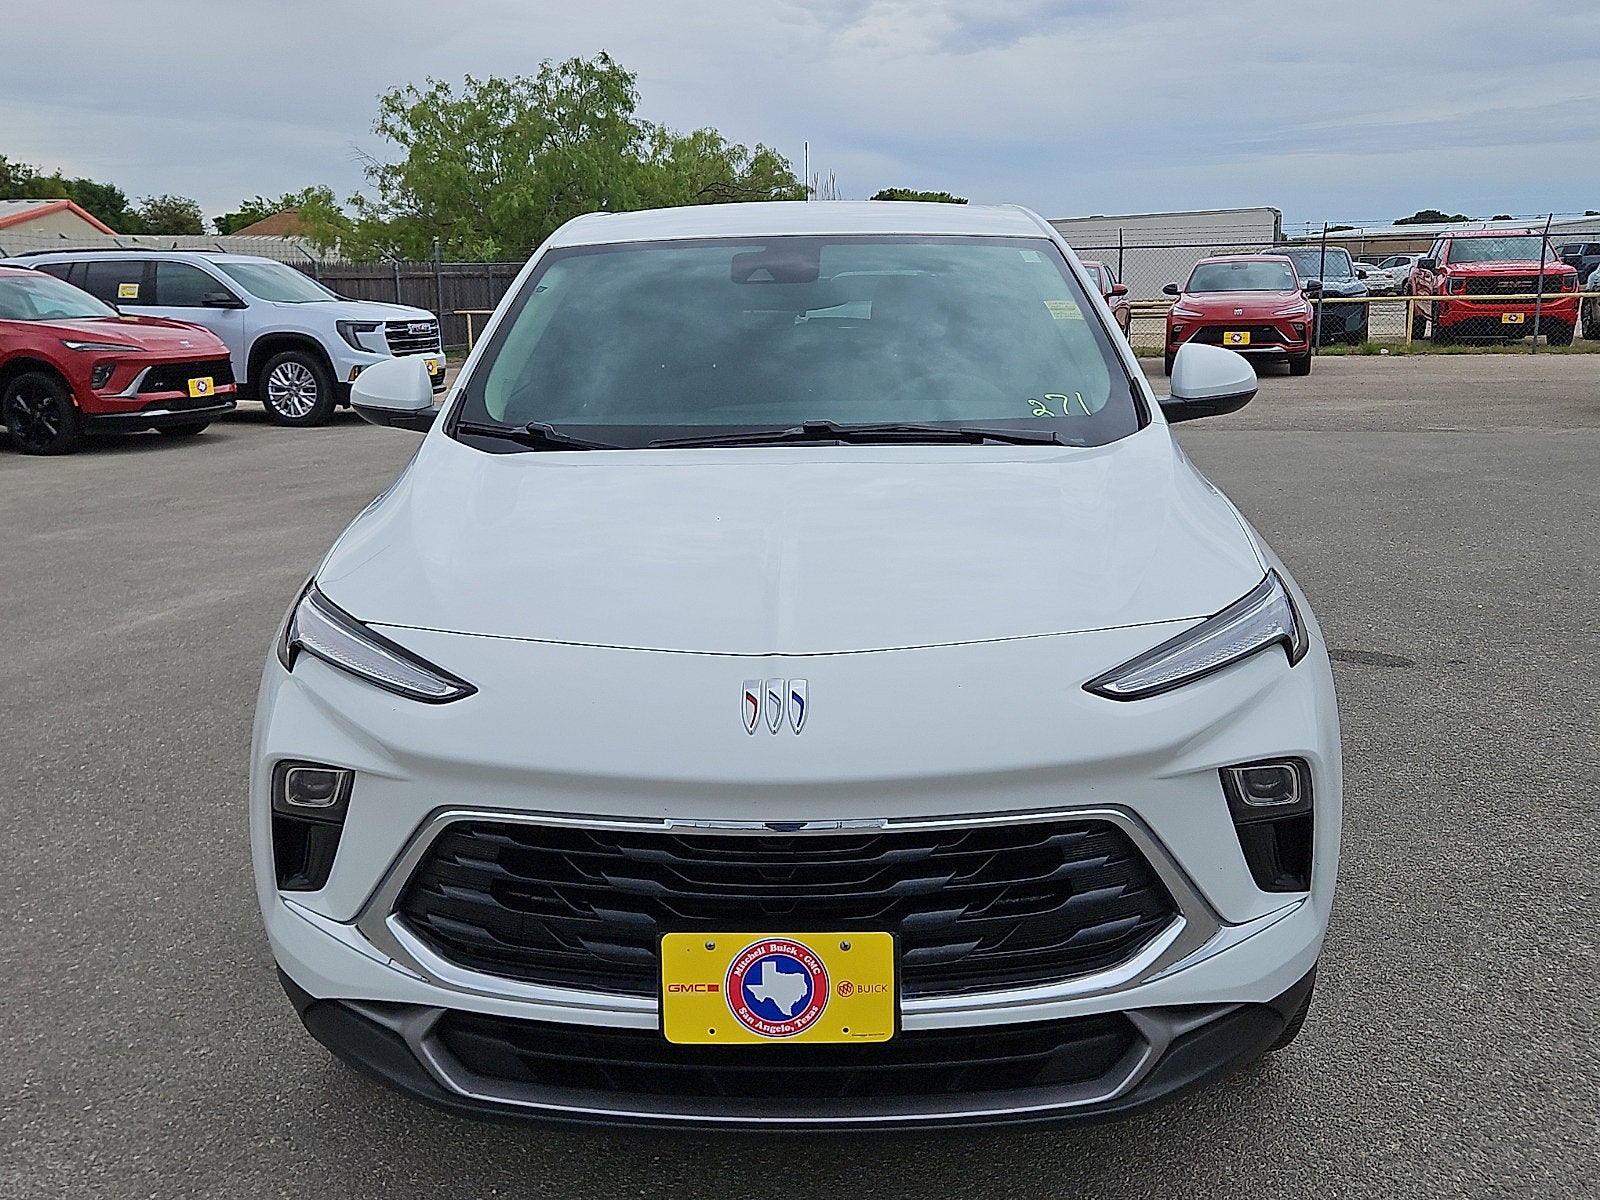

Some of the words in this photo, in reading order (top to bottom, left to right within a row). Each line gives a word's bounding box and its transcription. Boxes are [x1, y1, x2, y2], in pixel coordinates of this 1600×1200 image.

[1027, 391, 1092, 417] 271
[733, 946, 766, 977] Mitchell
[769, 944, 798, 956] Buick
[803, 955, 821, 975] GMC
[668, 984, 706, 993] GMC
[857, 984, 888, 993] BUICK
[738, 1007, 755, 1024] San
[755, 1021, 795, 1033] Angelo,
[794, 1006, 819, 1028] Texas
